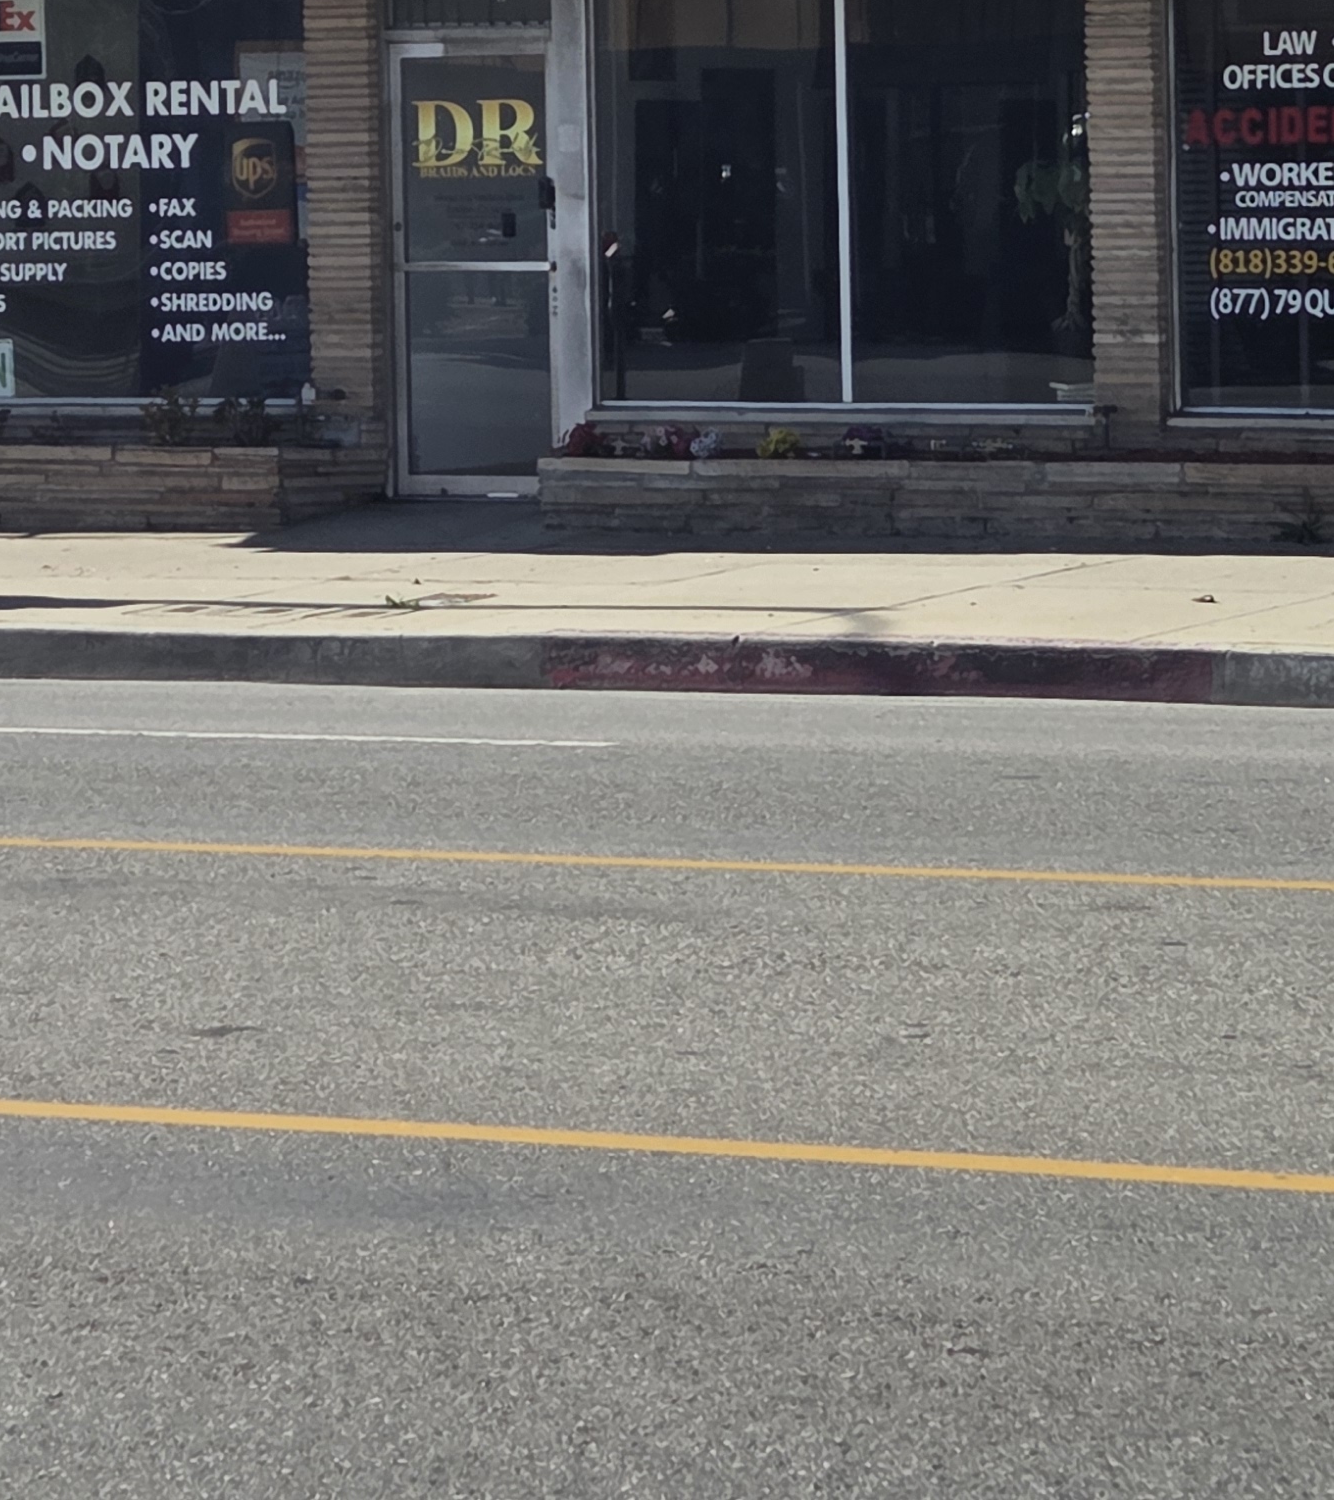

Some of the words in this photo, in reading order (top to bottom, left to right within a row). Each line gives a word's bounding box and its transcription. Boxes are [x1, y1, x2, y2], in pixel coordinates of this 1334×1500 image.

[1263, 30, 1317, 56] LAW
[1223, 63, 1320, 90] OFFICES
[145, 79, 287, 116] RENTAL
[412, 98, 544, 167] DR
[42, 132, 199, 170] NOTARY
[235, 155, 275, 190] ups
[27, 199, 42, 217] &
[48, 198, 133, 218] PACKING
[159, 198, 196, 218] FAX
[32, 231, 117, 251] PICTURES
[160, 229, 212, 250] SCAN
[0, 262, 67, 282] SUPPLY
[160, 261, 227, 281] COPIES
[161, 291, 274, 312] SHREDDING
[1210, 287, 1270, 320] (877)
[161, 323, 205, 343] AND
[211, 321, 287, 342] MORE...
